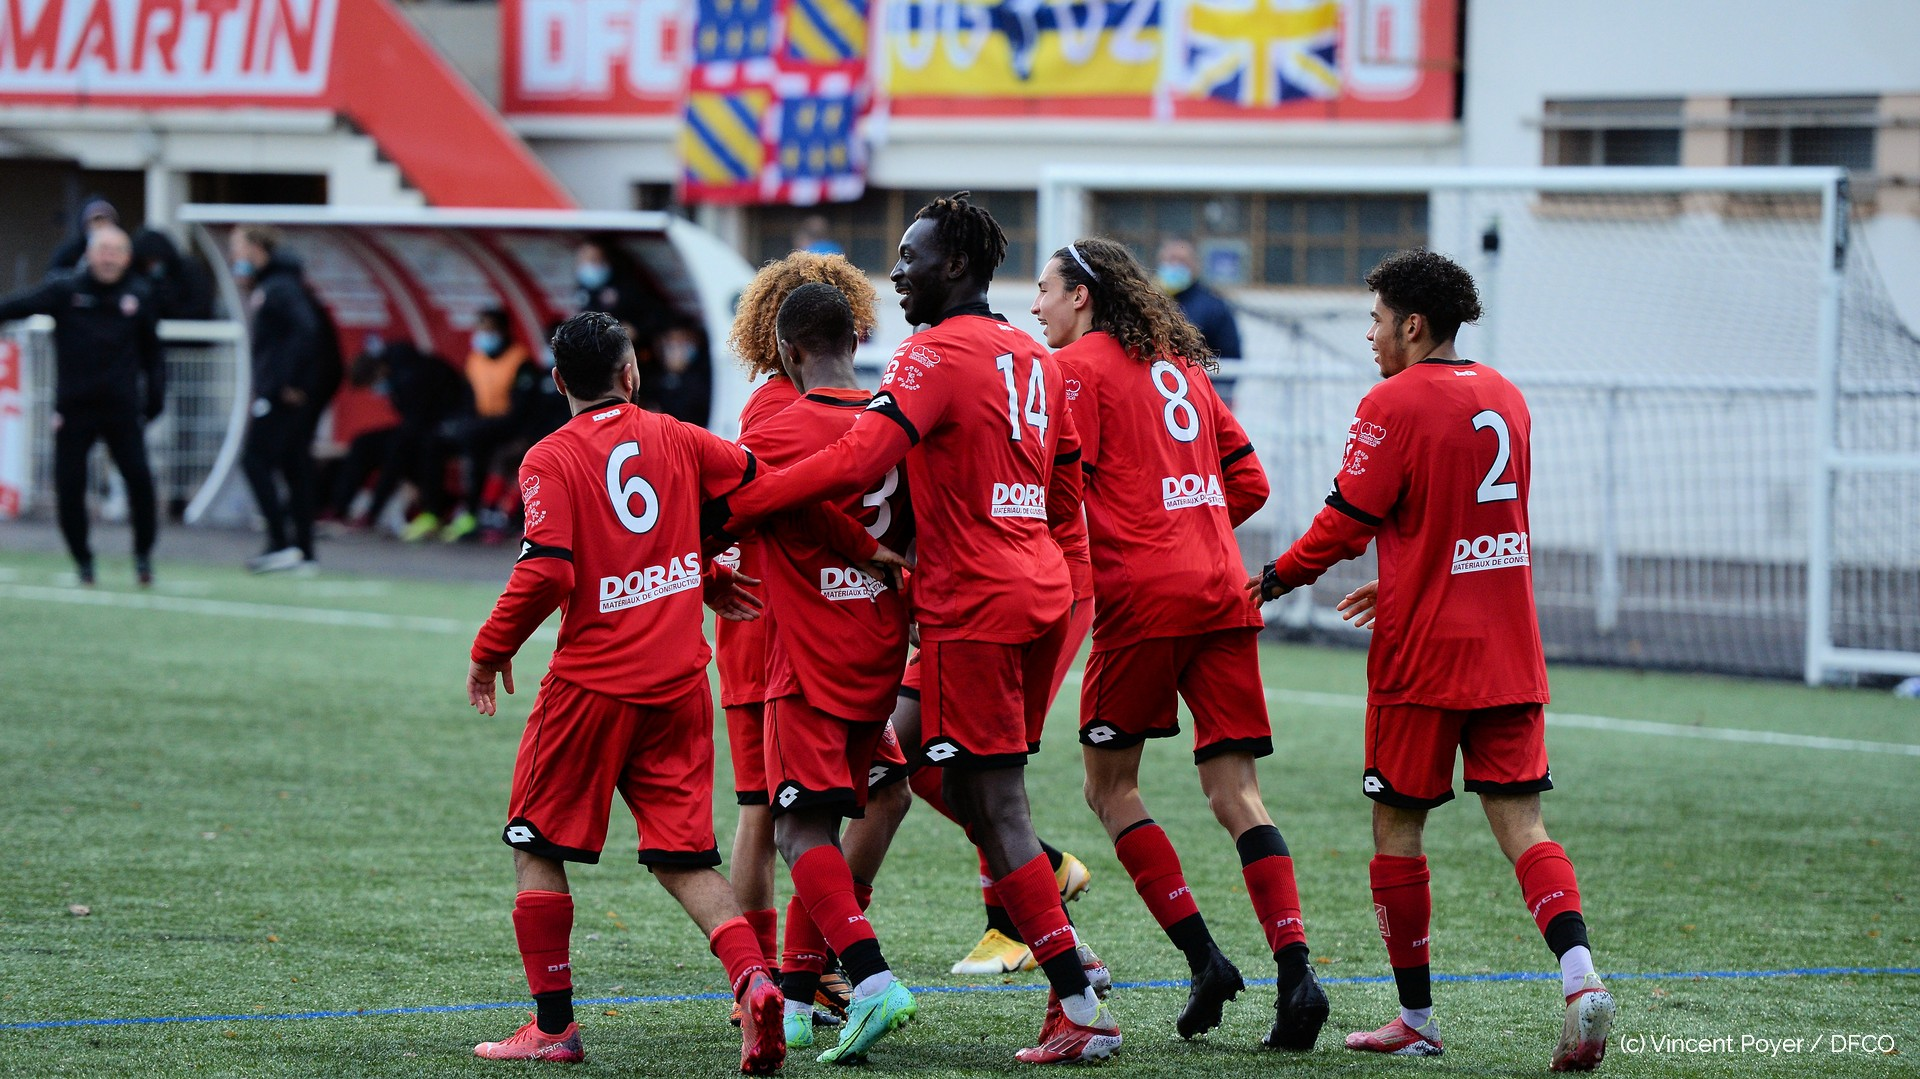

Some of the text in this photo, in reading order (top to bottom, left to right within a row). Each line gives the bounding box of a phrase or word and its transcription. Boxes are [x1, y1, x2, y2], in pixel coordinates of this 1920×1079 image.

[0, 0, 320, 72] MARTIN
[995, 352, 1048, 448] 14
[1151, 359, 1200, 443] 8
[605, 440, 659, 535] 6
[1471, 409, 1518, 505] 2
[600, 552, 701, 600] DORAS
[637, 591, 648, 601] DE
[648, 577, 700, 596] CONSTRUCTION
[1034, 924, 1070, 947] DFCO
